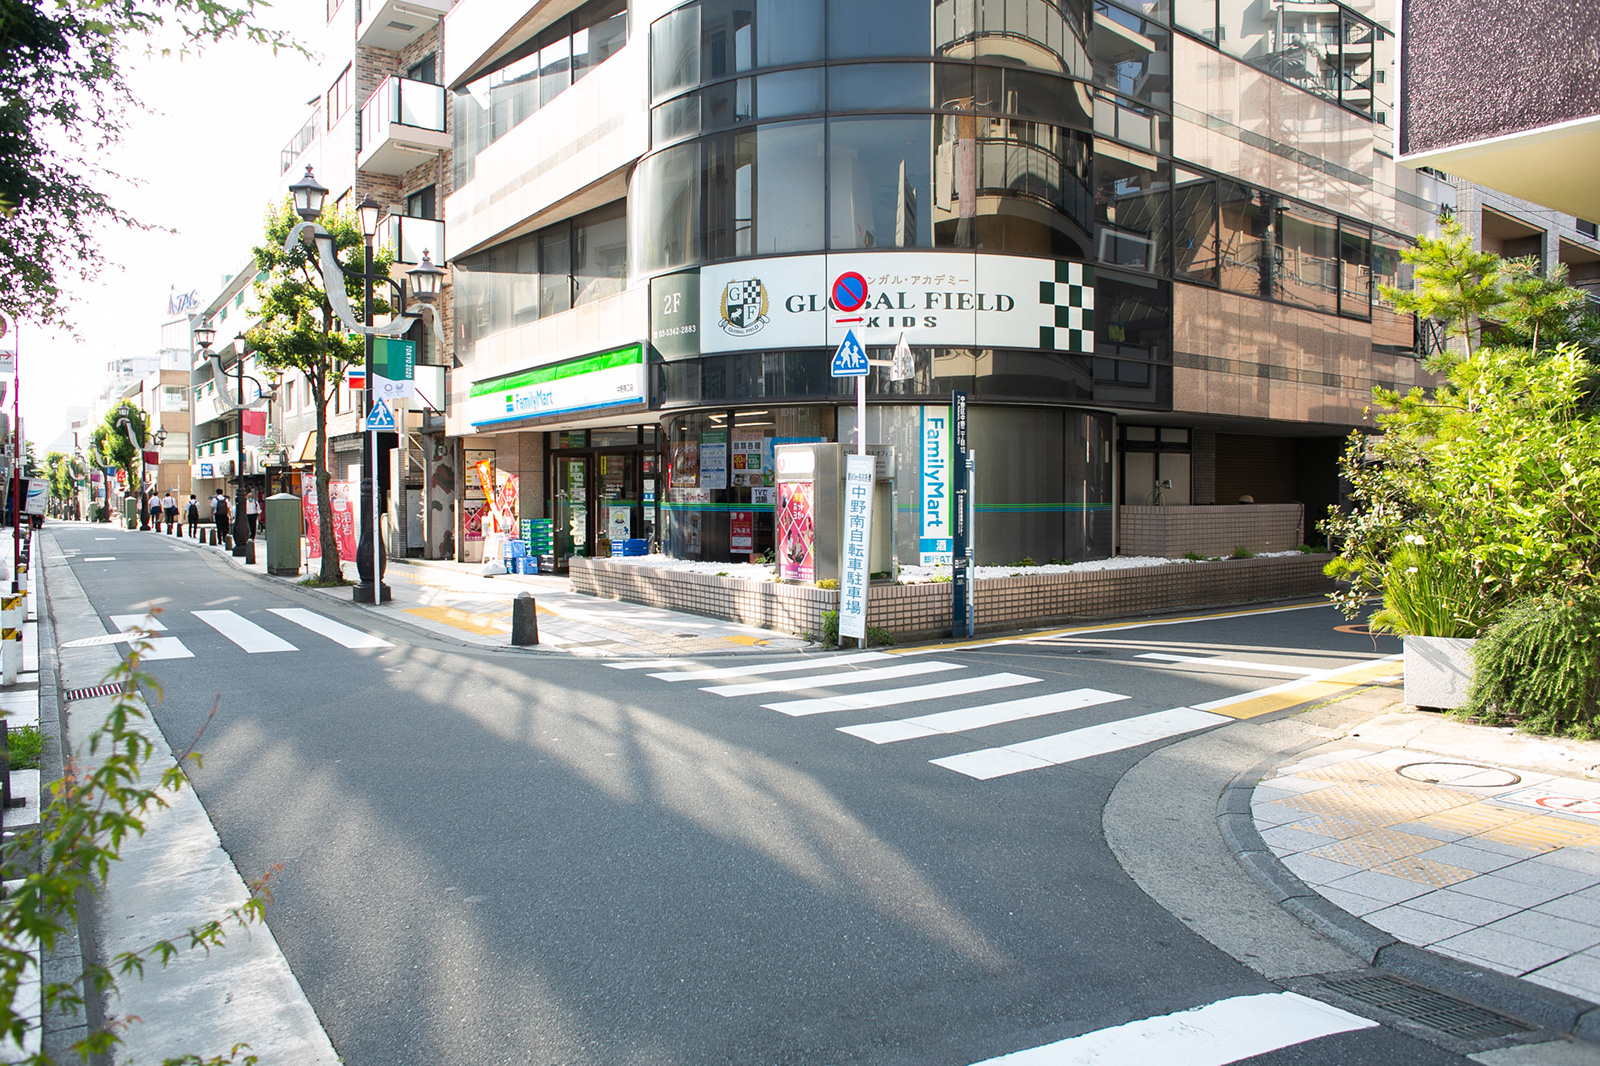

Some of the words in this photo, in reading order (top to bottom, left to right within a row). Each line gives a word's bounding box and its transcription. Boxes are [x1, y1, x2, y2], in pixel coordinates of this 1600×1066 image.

[729, 287, 741, 302] G
[785, 291, 915, 313] GLAL
[924, 292, 1015, 312] FIELD
[663, 292, 682, 315] 2F
[747, 305, 757, 320] F
[867, 315, 937, 328] KIDS
[658, 324, 697, 338] 03-5342-2883
[728, 326, 745, 335] GLOBAL
[745, 324, 760, 334] FIELD
[405, 345, 413, 364] TOKYO
[405, 364, 413, 379] 2020
[515, 390, 554, 413] FamilyMart
[924, 417, 945, 528] FamilyMart
[845, 485, 867, 615] 中野南自転車駐車場
[936, 539, 947, 551] 酒
[924, 554, 952, 564] 銀行AT
